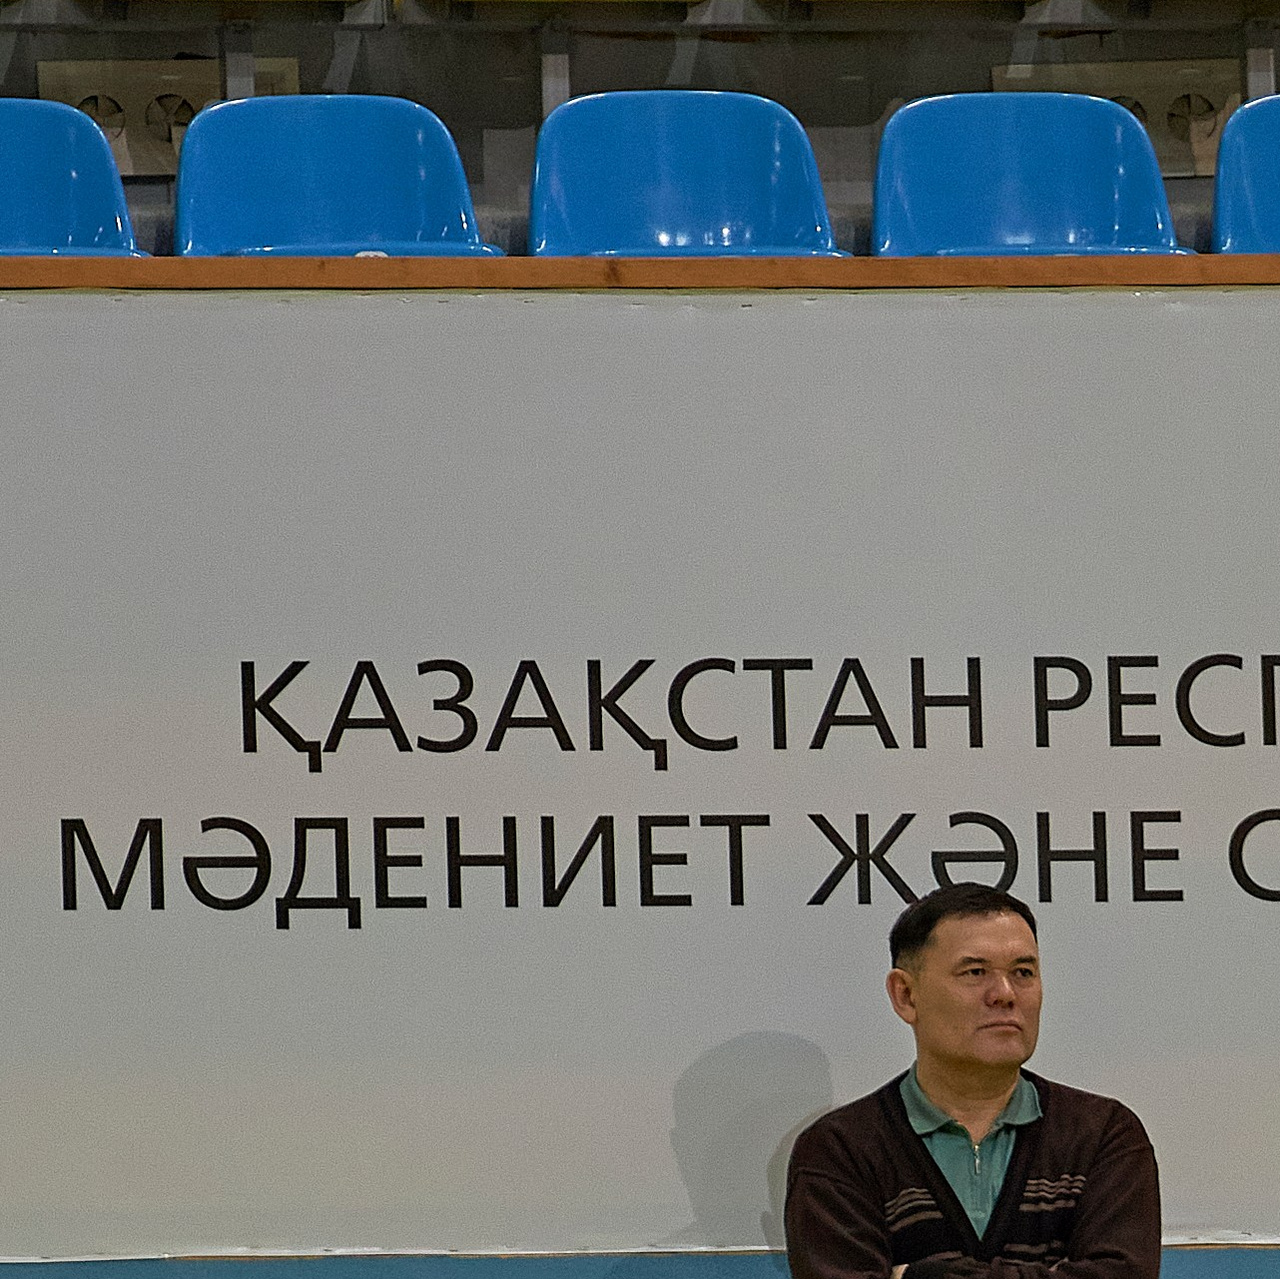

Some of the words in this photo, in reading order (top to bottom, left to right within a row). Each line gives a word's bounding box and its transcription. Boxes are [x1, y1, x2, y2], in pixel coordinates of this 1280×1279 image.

[241, 657, 983, 773] ҚАЗАҚСТАН
[61, 815, 770, 930] МӘДЕНИЕТ
[806, 811, 1184, 906] ЖӘНЕ
